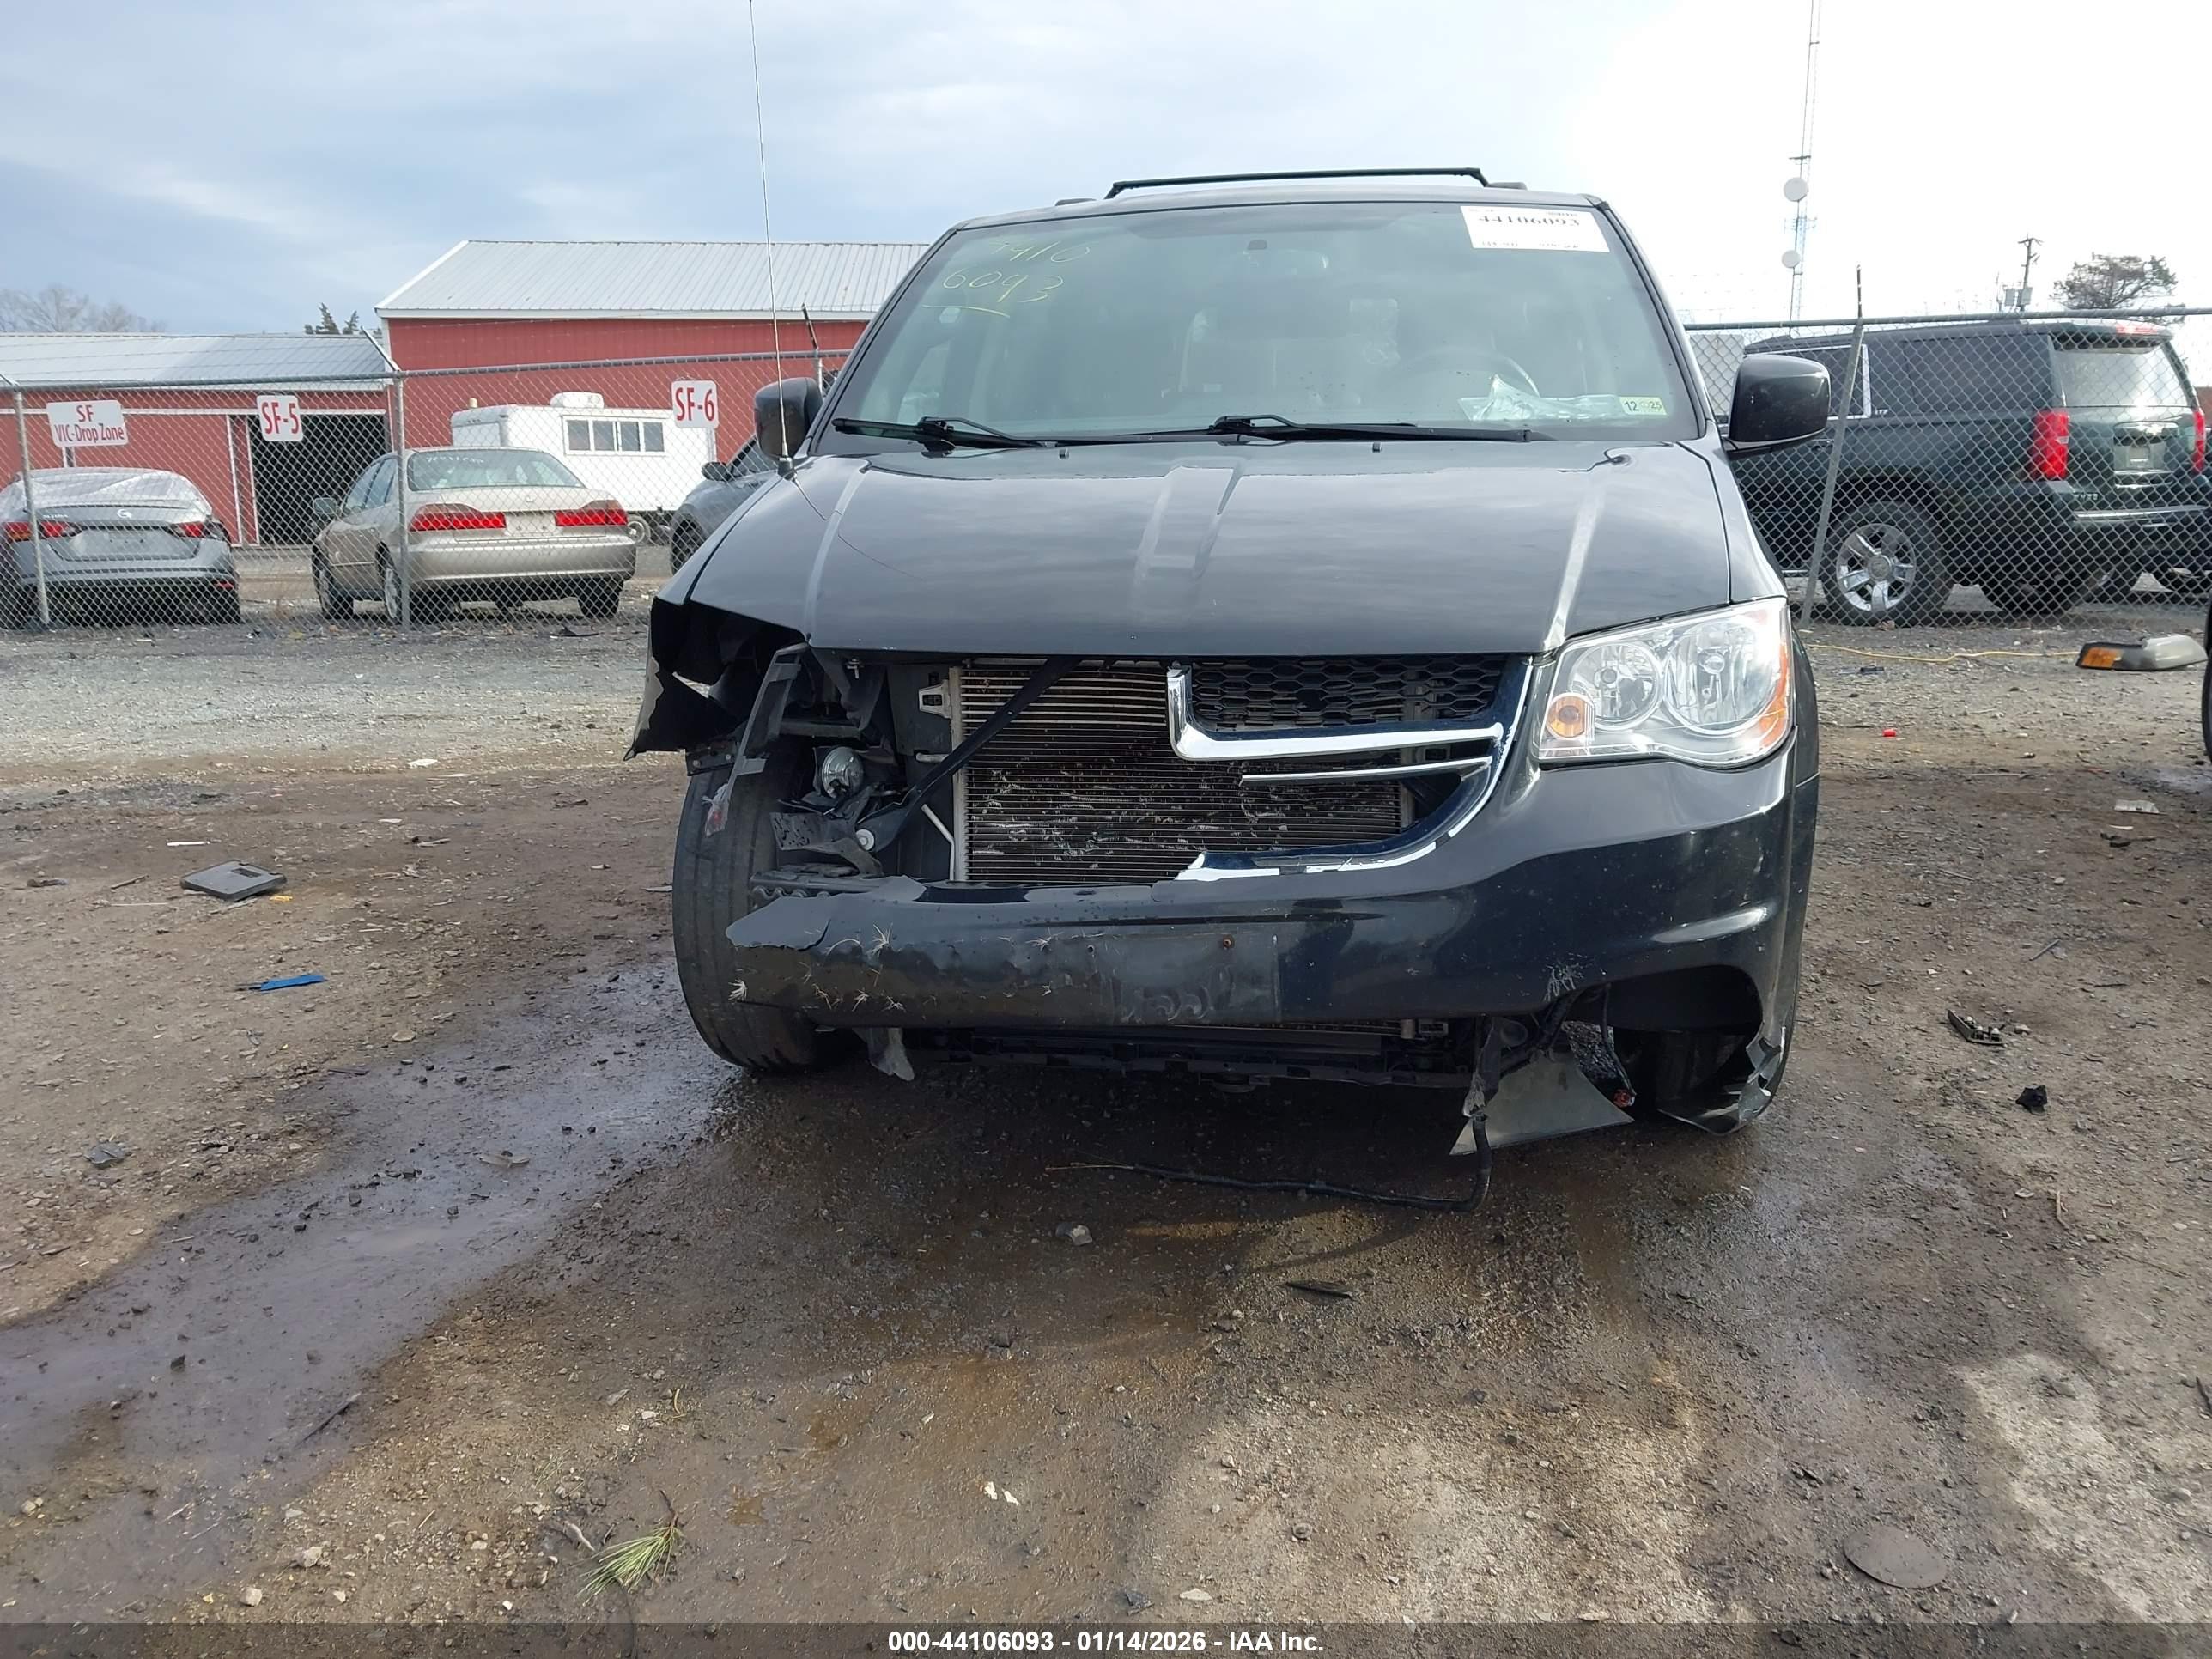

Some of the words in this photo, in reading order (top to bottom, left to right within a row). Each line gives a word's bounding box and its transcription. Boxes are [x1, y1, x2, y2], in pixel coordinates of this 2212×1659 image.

[942, 265, 1064, 304] 6093
[76, 404, 94, 422] SF
[261, 401, 299, 434] SF-5
[675, 386, 714, 422] SF-6
[1624, 400, 1639, 411] 12
[54, 424, 98, 443] VIC-Drop
[98, 422, 125, 441] Zone
